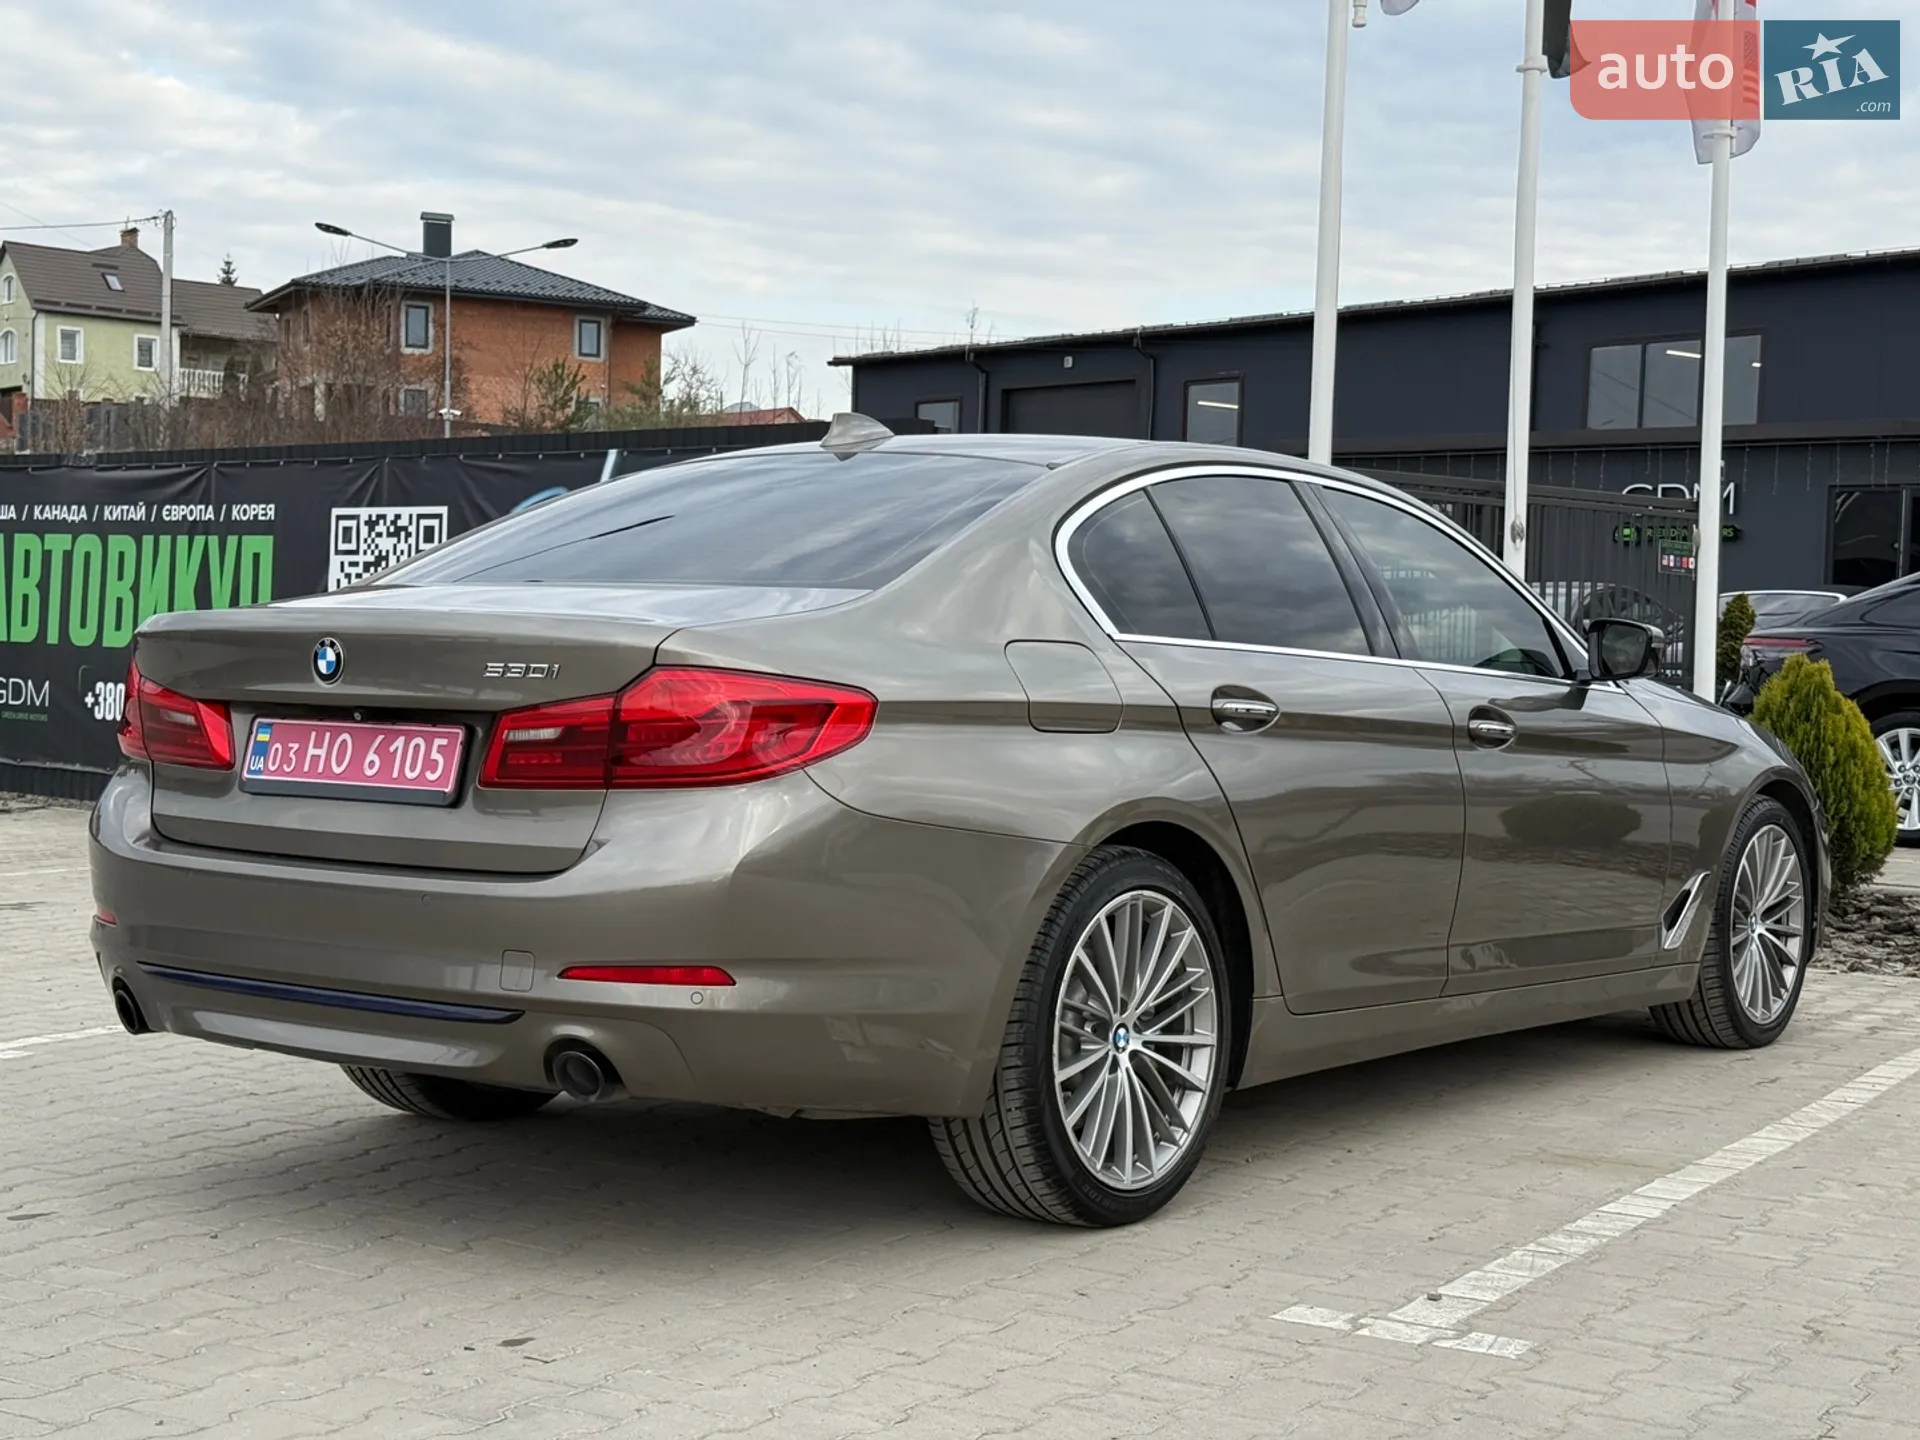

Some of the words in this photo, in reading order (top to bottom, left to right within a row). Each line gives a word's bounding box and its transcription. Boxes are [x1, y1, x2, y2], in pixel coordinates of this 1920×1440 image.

[33, 504, 88, 523] КАНАДА
[103, 501, 146, 521] КИТАЙ
[162, 504, 215, 521] ЄВРОПА
[231, 503, 275, 521] КОРЕЯ
[0, 533, 275, 648] ВТОВИКУП
[483, 662, 560, 679] 530i
[250, 755, 264, 771] UA
[268, 743, 299, 773] 03
[363, 735, 448, 781] 6105
